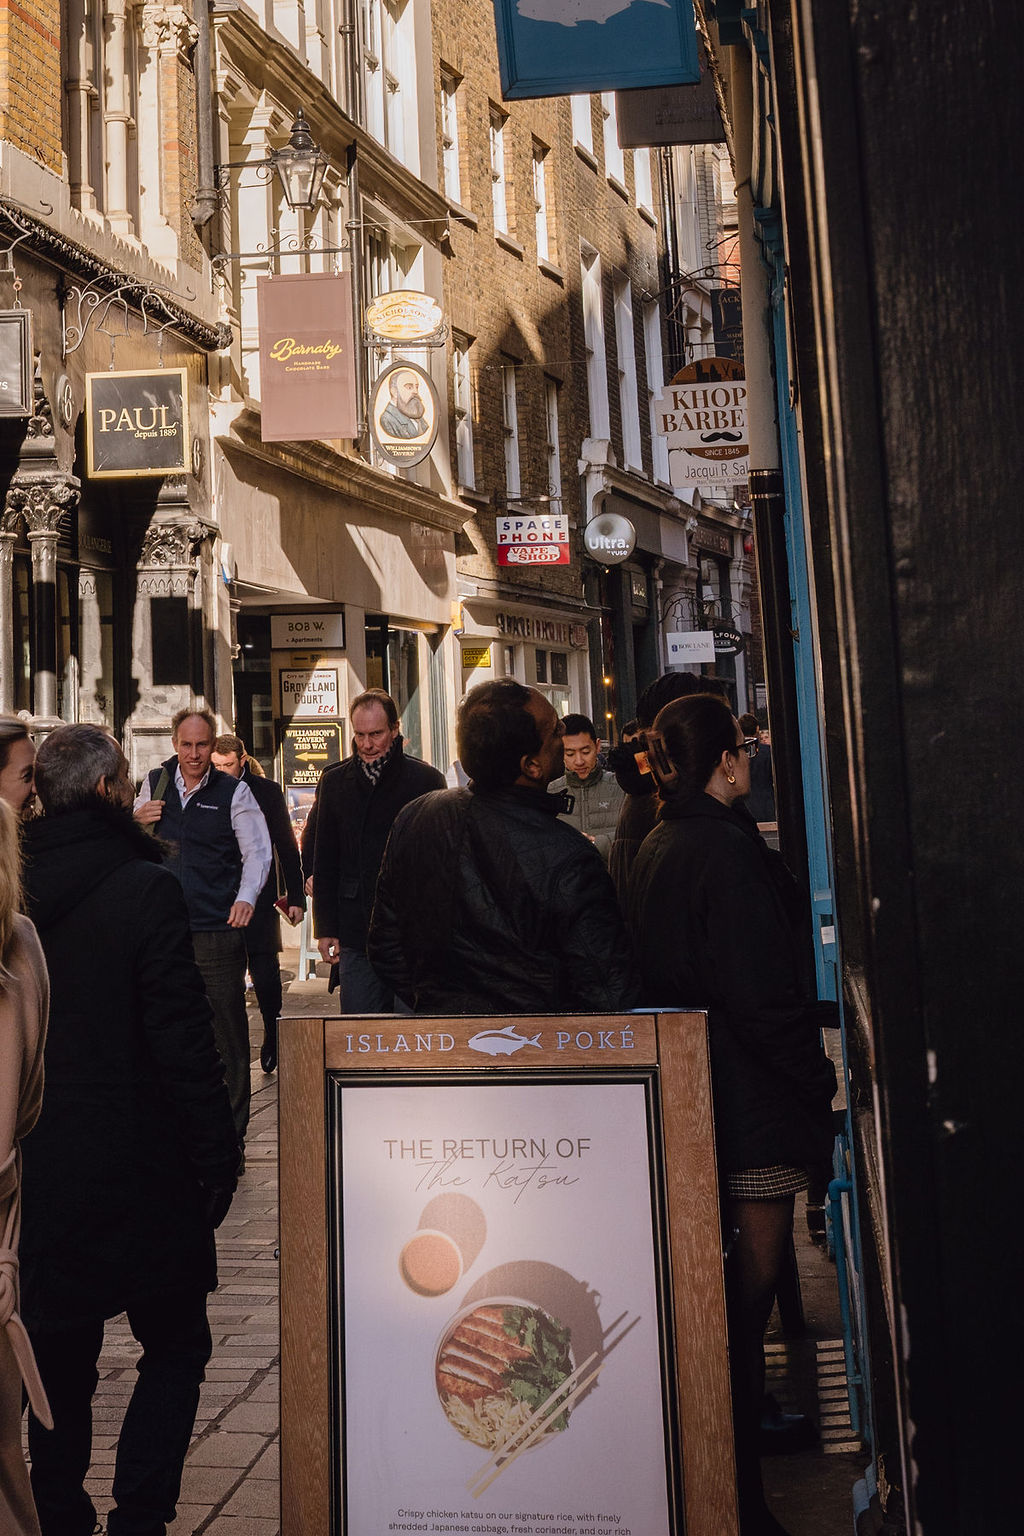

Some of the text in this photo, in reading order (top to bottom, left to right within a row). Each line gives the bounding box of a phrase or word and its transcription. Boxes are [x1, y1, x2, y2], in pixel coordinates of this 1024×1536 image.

[270, 338, 343, 362] Barnaby
[98, 404, 179, 433] PAUL
[662, 407, 748, 433] BARBE
[134, 428, 177, 440] depuis 1889
[705, 449, 723, 457] SINCE
[685, 465, 719, 480] Jacqui
[721, 463, 728, 476] R
[503, 520, 562, 531] SPACE
[499, 532, 566, 543] PHONE
[588, 536, 630, 550] Ultra.
[518, 553, 558, 561] SHOP
[288, 621, 325, 632] BOB W.
[714, 632, 741, 642] LFOUR
[283, 680, 335, 693] GROVELAND
[294, 693, 324, 704] COURT
[317, 705, 335, 714] EC4
[286, 729, 336, 737] WILLIAMSON'S
[308, 763, 315, 771] &
[345, 1025, 636, 1054] ISLAND POKÉ
[383, 1138, 592, 1160] THE RETURN OF
[414, 1145, 581, 1205] The Katsu
[397, 1509, 425, 1520] Crispy
[426, 1510, 459, 1519] chicken
[460, 1510, 484, 1519] katsu
[514, 1511, 555, 1522] signature
[556, 1512, 575, 1522] rice,
[576, 1512, 595, 1522] with
[597, 1513, 621, 1524] finely
[388, 1522, 632, 1536] shredded Japanese cabbage, fresh coriander, and our rich
